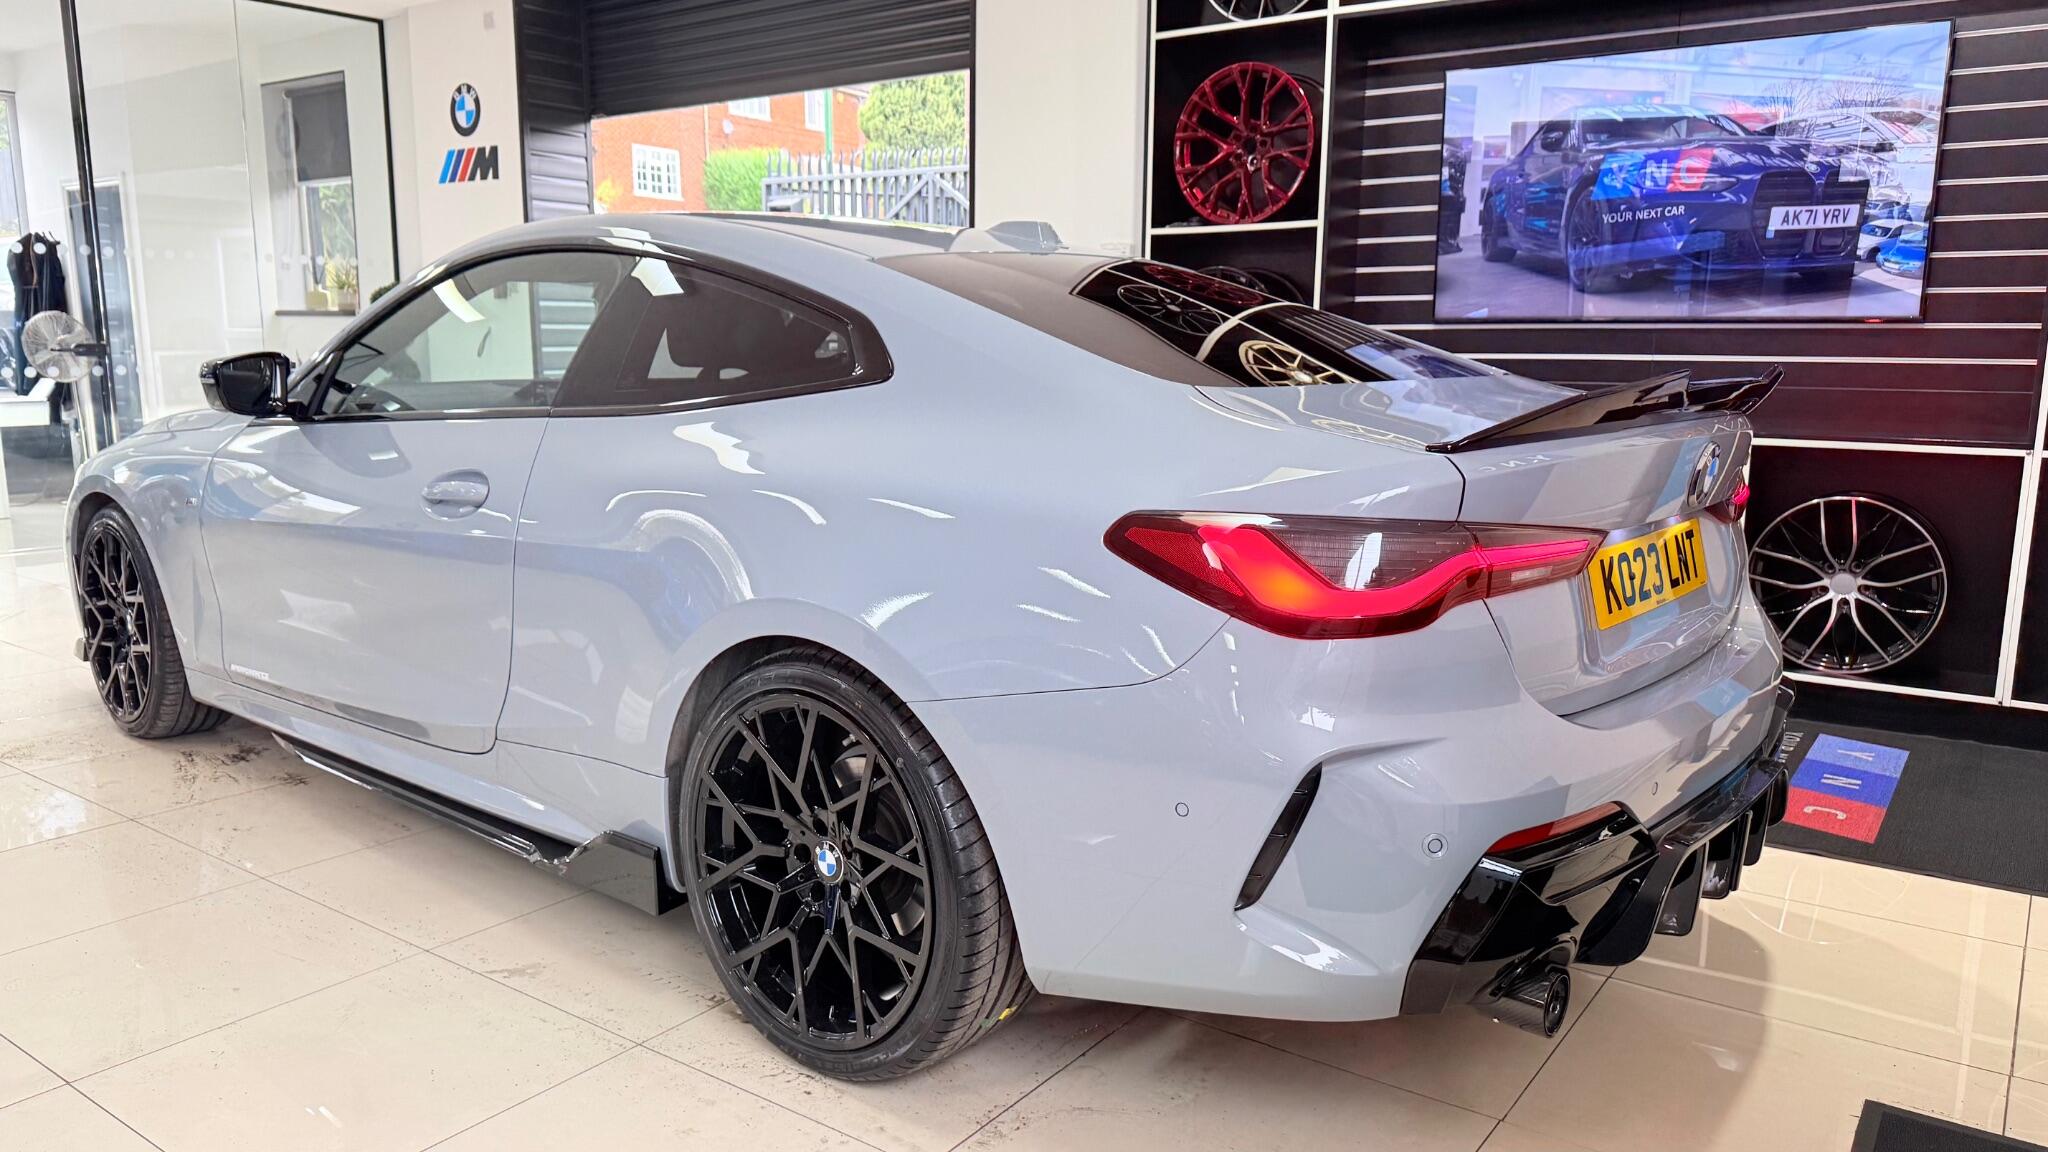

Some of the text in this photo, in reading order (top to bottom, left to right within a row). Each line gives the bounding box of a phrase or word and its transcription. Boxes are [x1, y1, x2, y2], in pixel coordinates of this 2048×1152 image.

[1602, 204, 1685, 224] YOUR NEXT CAR
[1780, 207, 1851, 226] AK71 YRV
[1663, 529, 1698, 589] LNT
